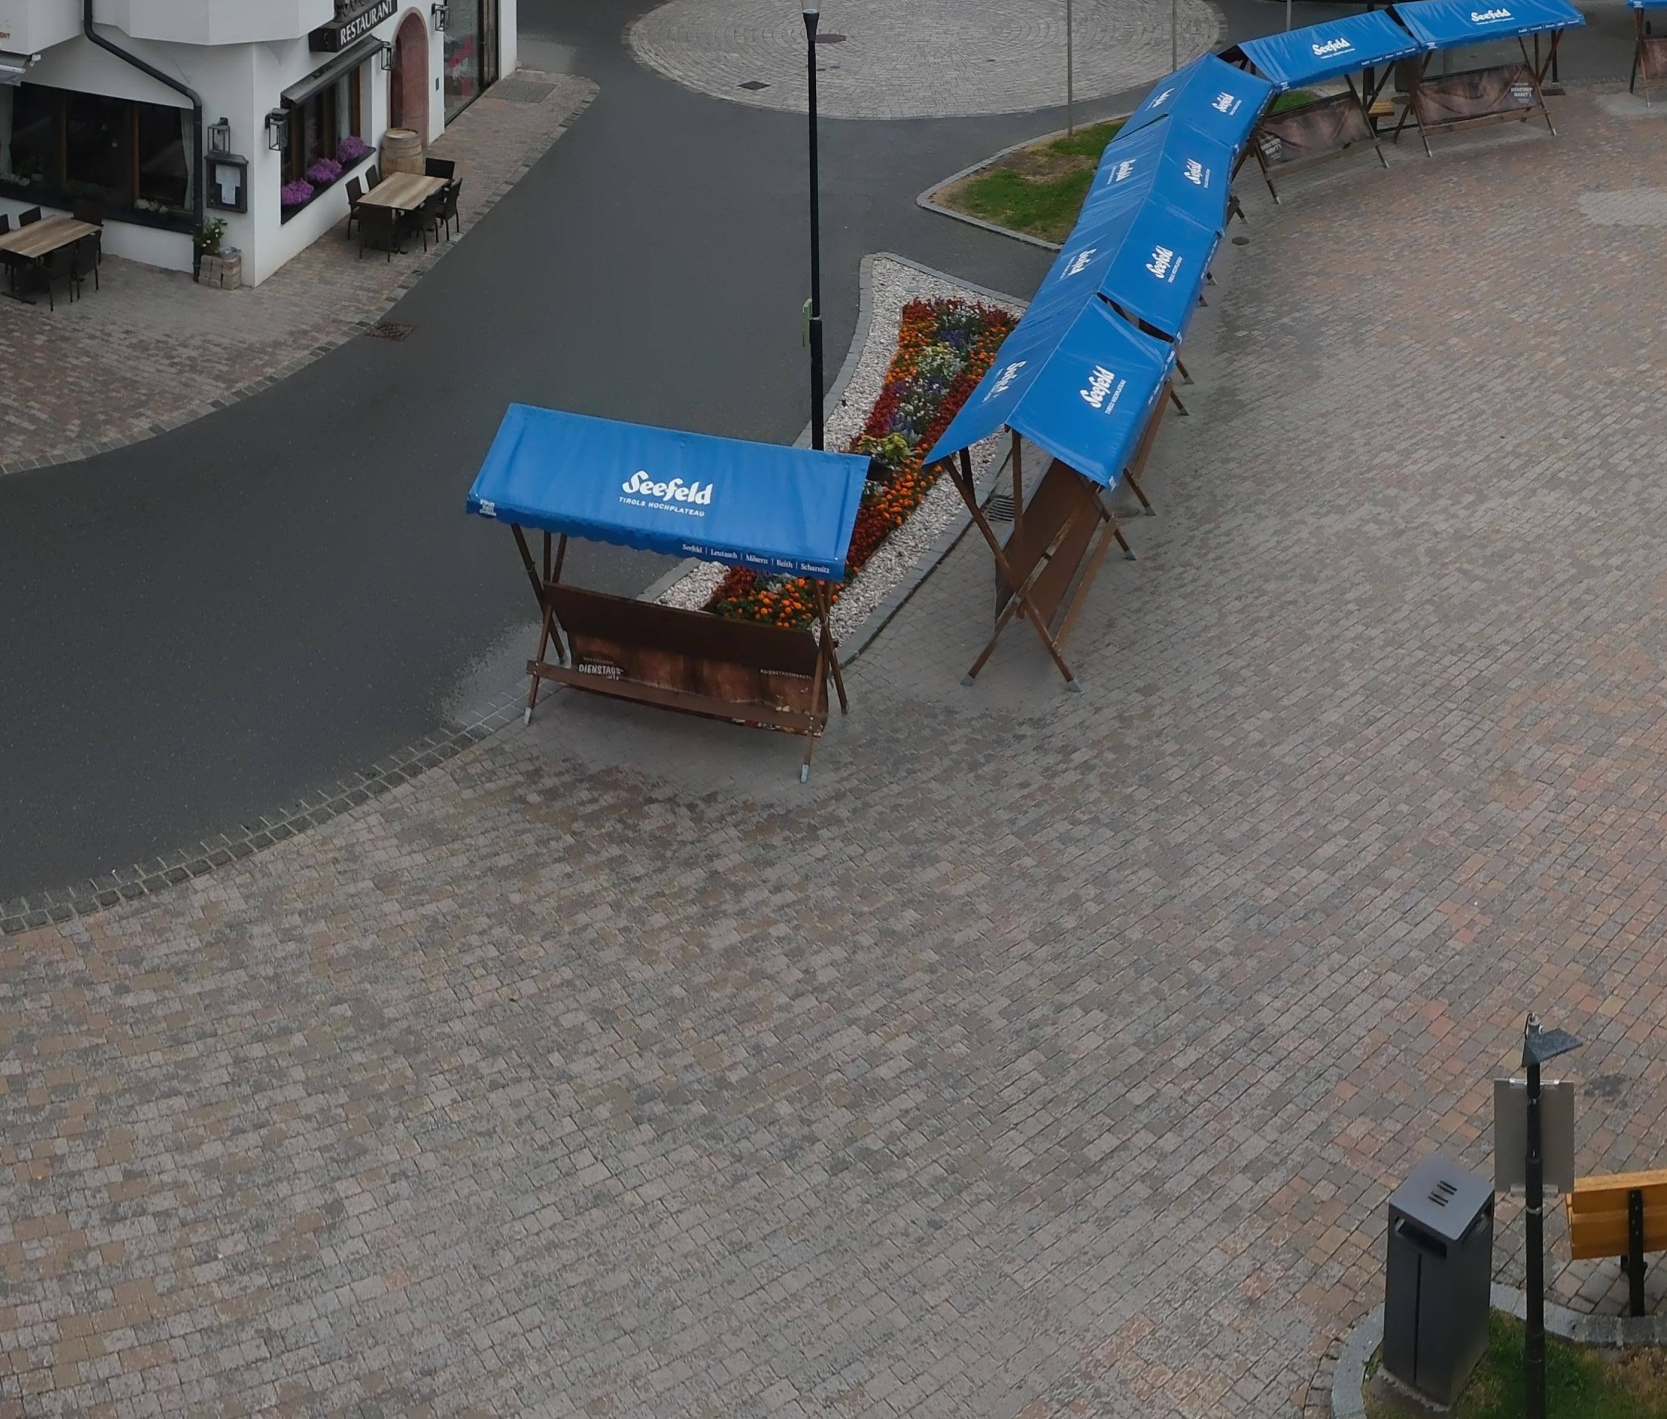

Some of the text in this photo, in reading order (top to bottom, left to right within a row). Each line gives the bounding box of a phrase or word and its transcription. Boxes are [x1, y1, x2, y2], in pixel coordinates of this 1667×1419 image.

[1471, 8, 1512, 22] Seefeld
[1312, 37, 1351, 57] Seefeld
[1145, 245, 1174, 279] Seefeld
[1079, 364, 1116, 409] Seefeld
[621, 469, 713, 506] Seefeld
[618, 496, 705, 518] TIROLS HOCHPLATEAU
[682, 543, 830, 574] Seefeld Leutasch Mösern Reith Scharnitz
